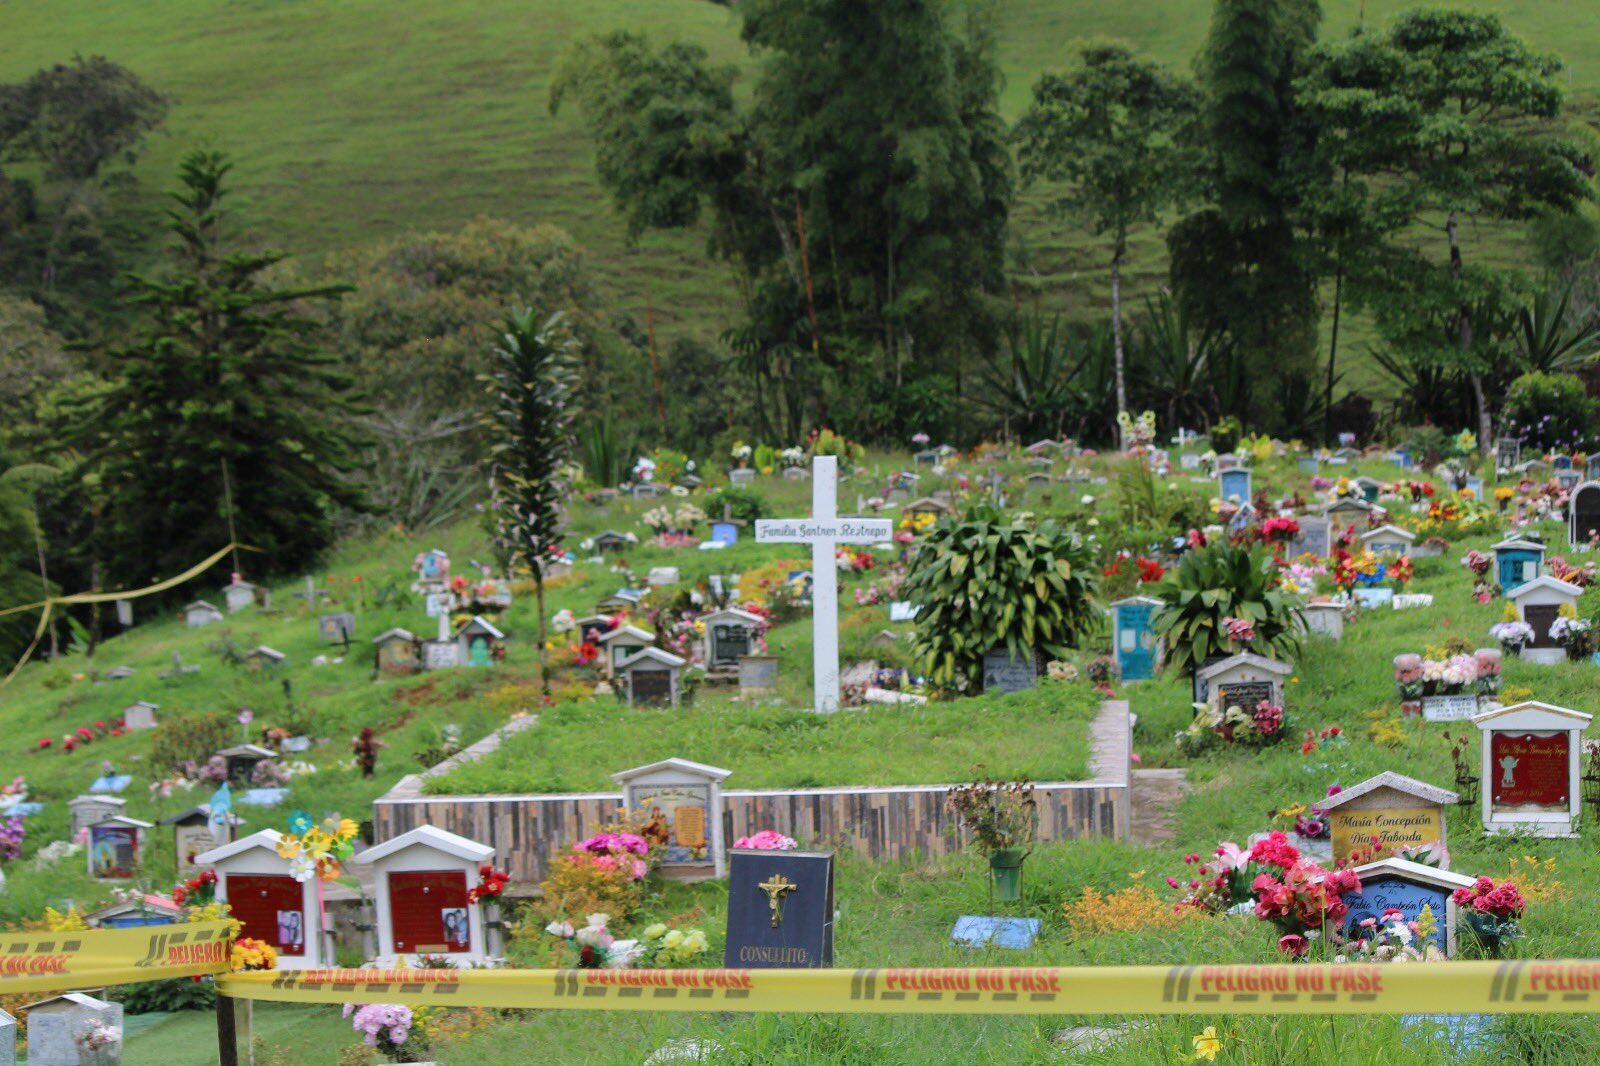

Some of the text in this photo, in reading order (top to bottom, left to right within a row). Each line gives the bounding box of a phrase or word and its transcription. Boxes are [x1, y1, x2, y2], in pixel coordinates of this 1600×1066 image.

[760, 524, 796, 539] Familia
[1339, 814, 1432, 829] María Concepción
[885, 967, 1063, 992] PELIGRO NO PASE
[1200, 964, 1384, 992] PELIGRO NO PASE
